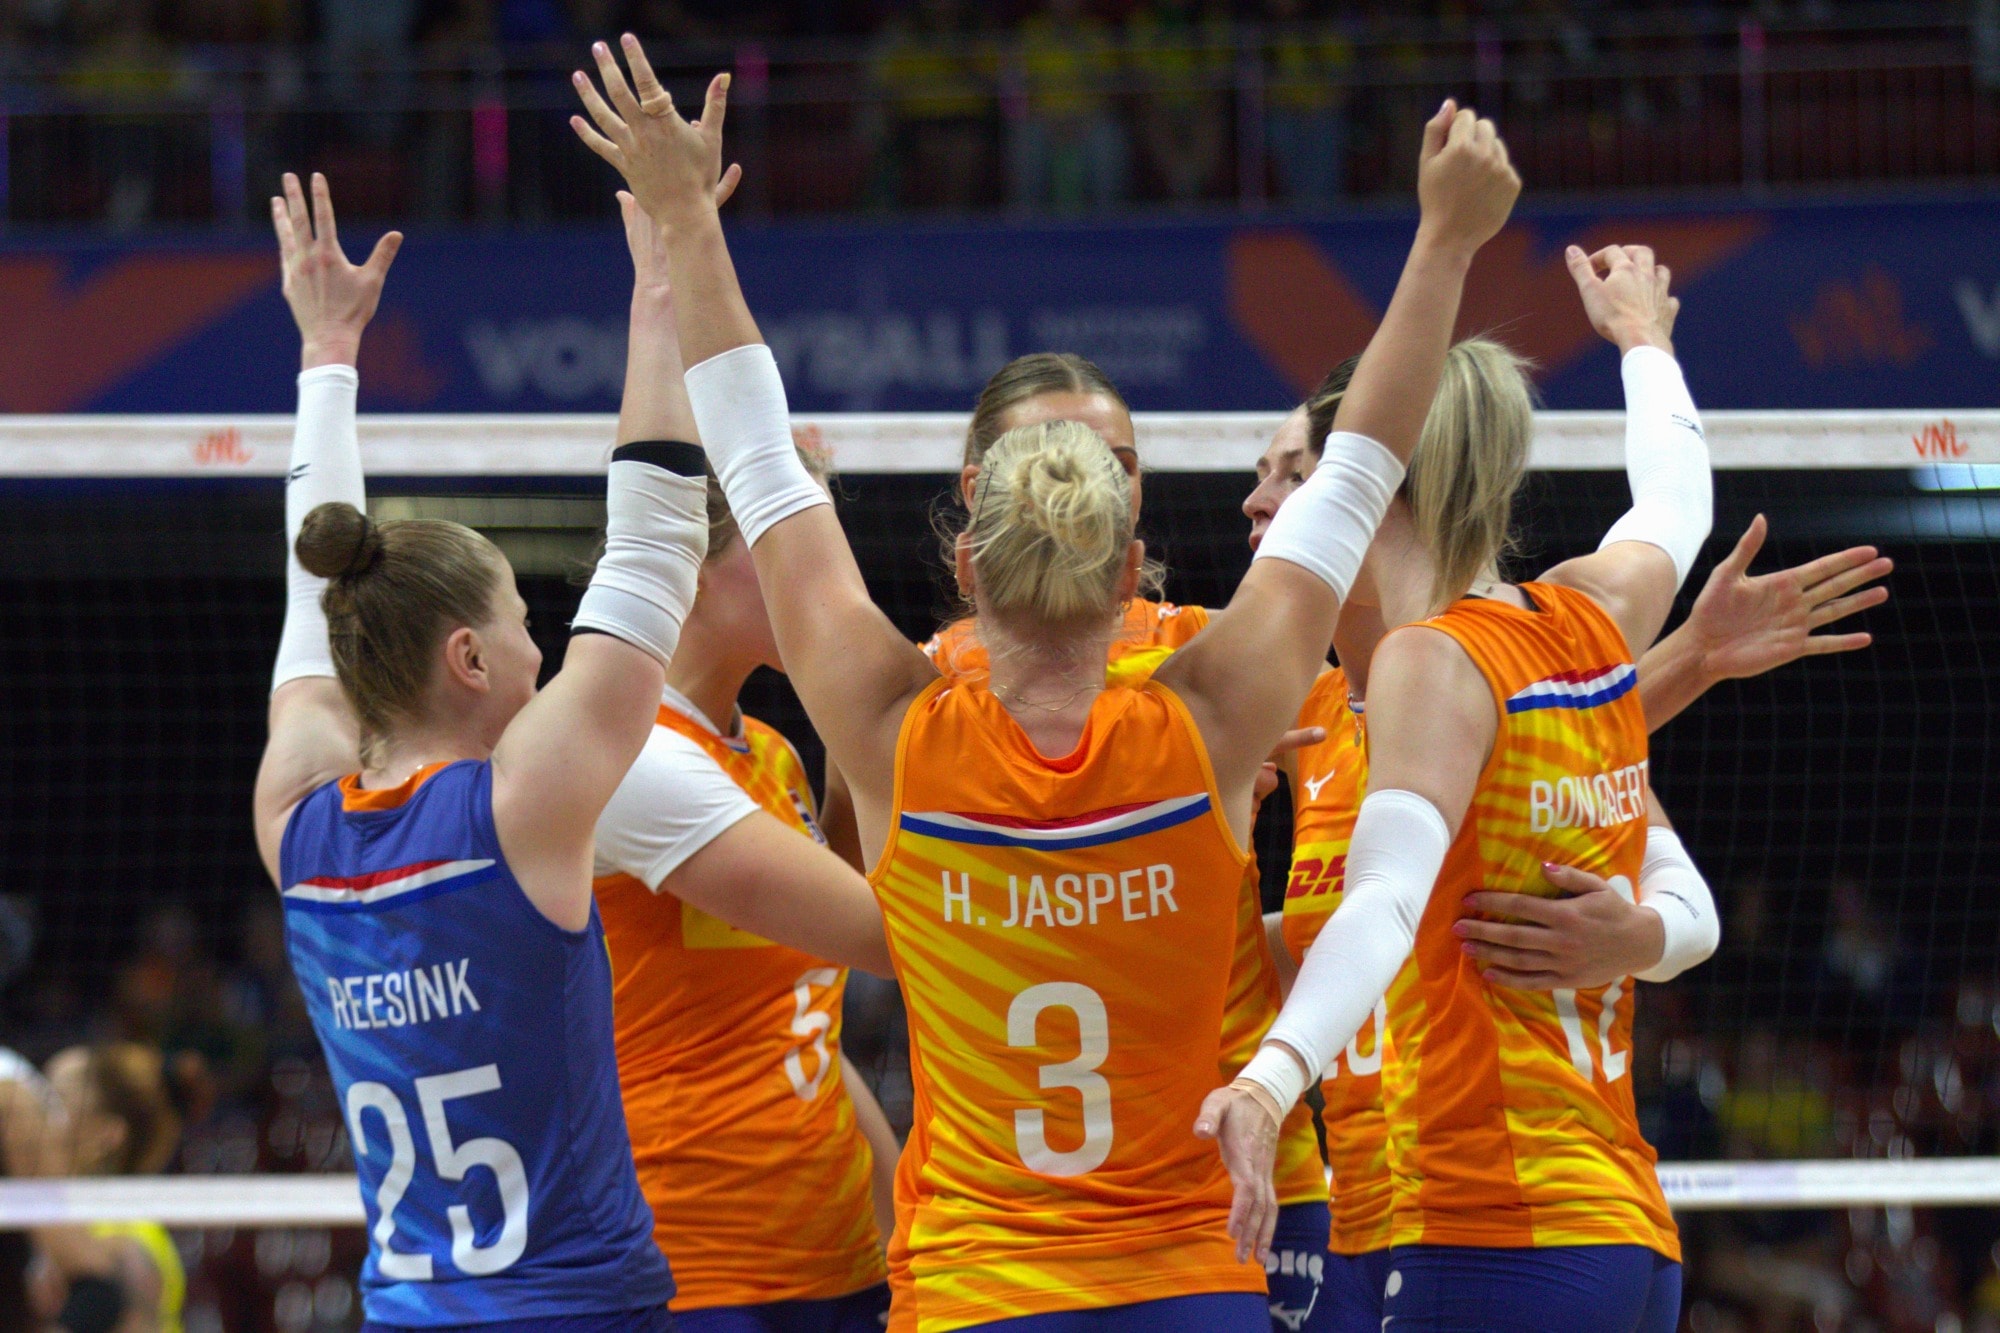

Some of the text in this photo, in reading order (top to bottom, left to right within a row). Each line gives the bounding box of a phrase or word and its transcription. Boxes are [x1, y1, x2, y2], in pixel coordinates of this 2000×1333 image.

[1911, 417, 1969, 458] VNL
[941, 863, 1179, 929] H. JASPER
[1286, 854, 1348, 899] DH
[326, 957, 481, 1031] REESINK
[1007, 981, 1114, 1178] 3
[346, 1063, 530, 1281] 25
